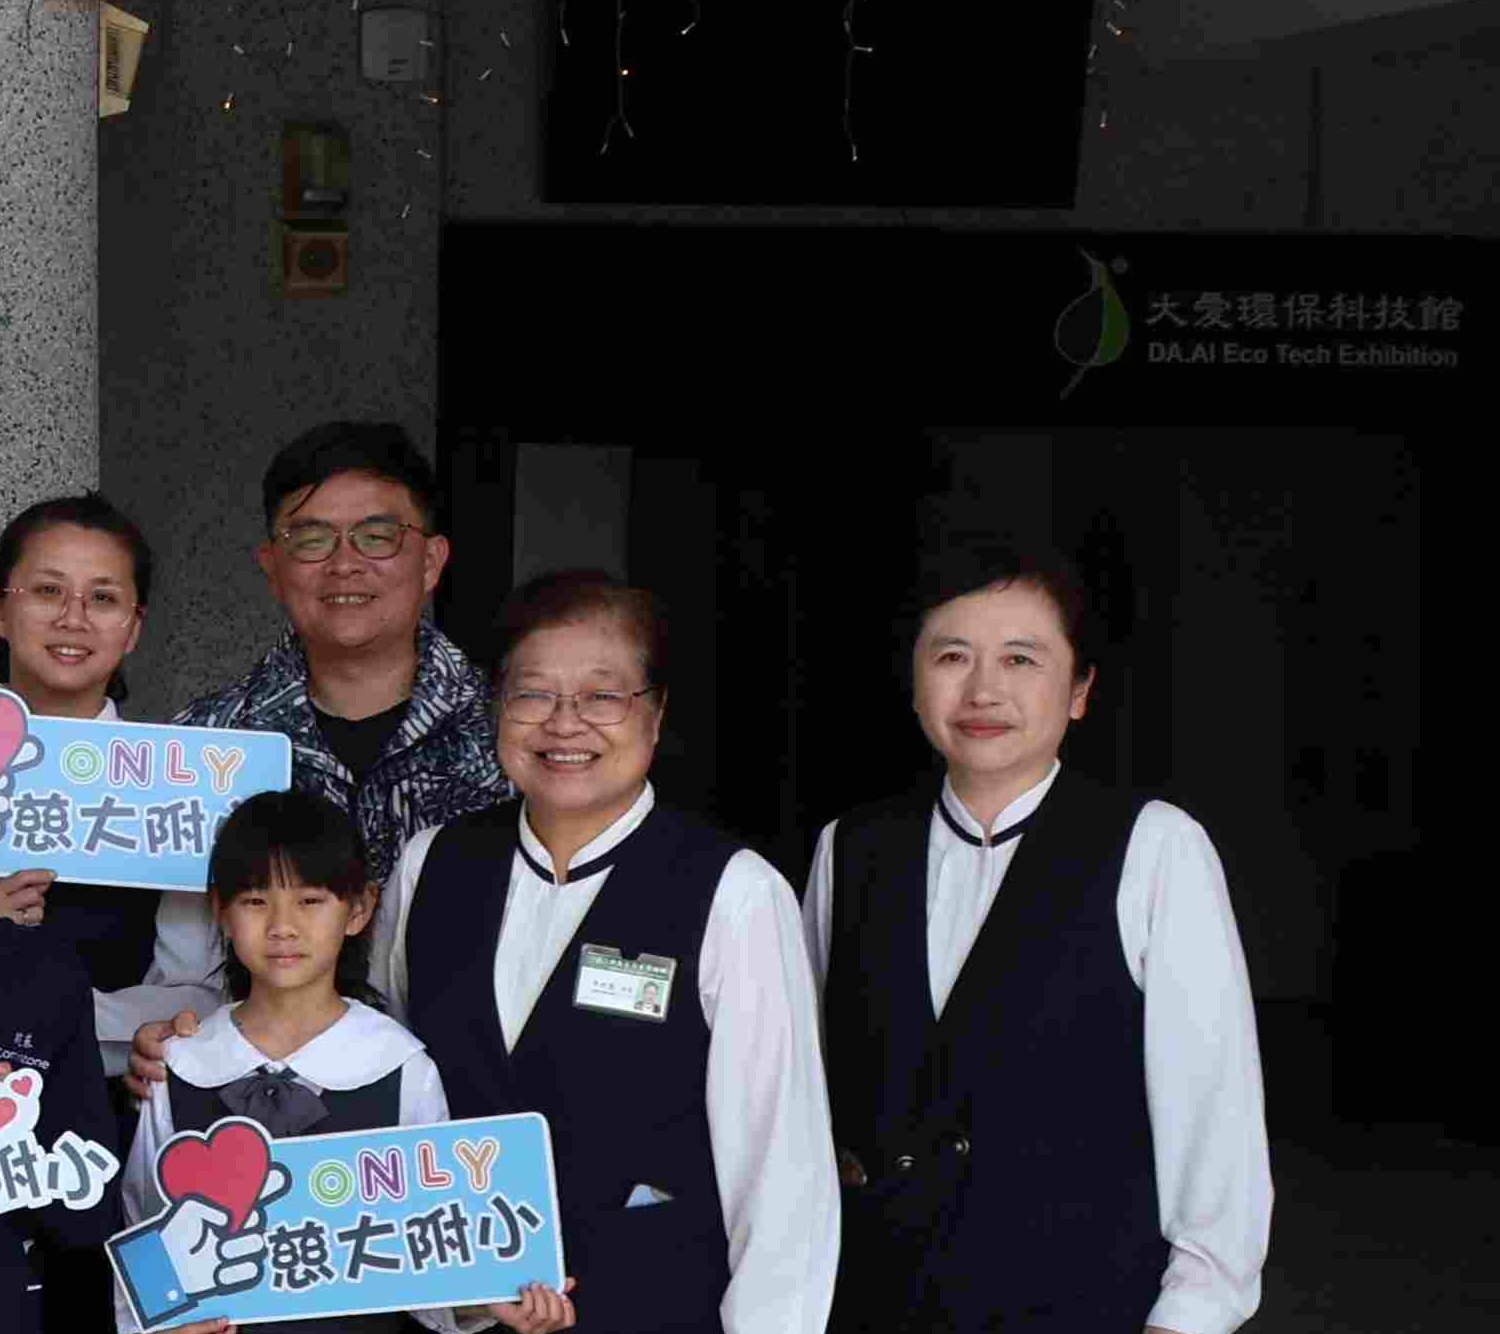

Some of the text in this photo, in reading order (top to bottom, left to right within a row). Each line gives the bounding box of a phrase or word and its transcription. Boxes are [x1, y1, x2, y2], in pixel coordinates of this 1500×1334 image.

[1223, 342, 1268, 365] Eco
[1275, 342, 1331, 366] Tech
[1339, 343, 1459, 368] Exhibition
[62, 738, 244, 793] ONLY
[11, 791, 242, 855] 慈大附
[310, 1138, 498, 1205] ONLY
[267, 1194, 542, 1290] 慈大附小
